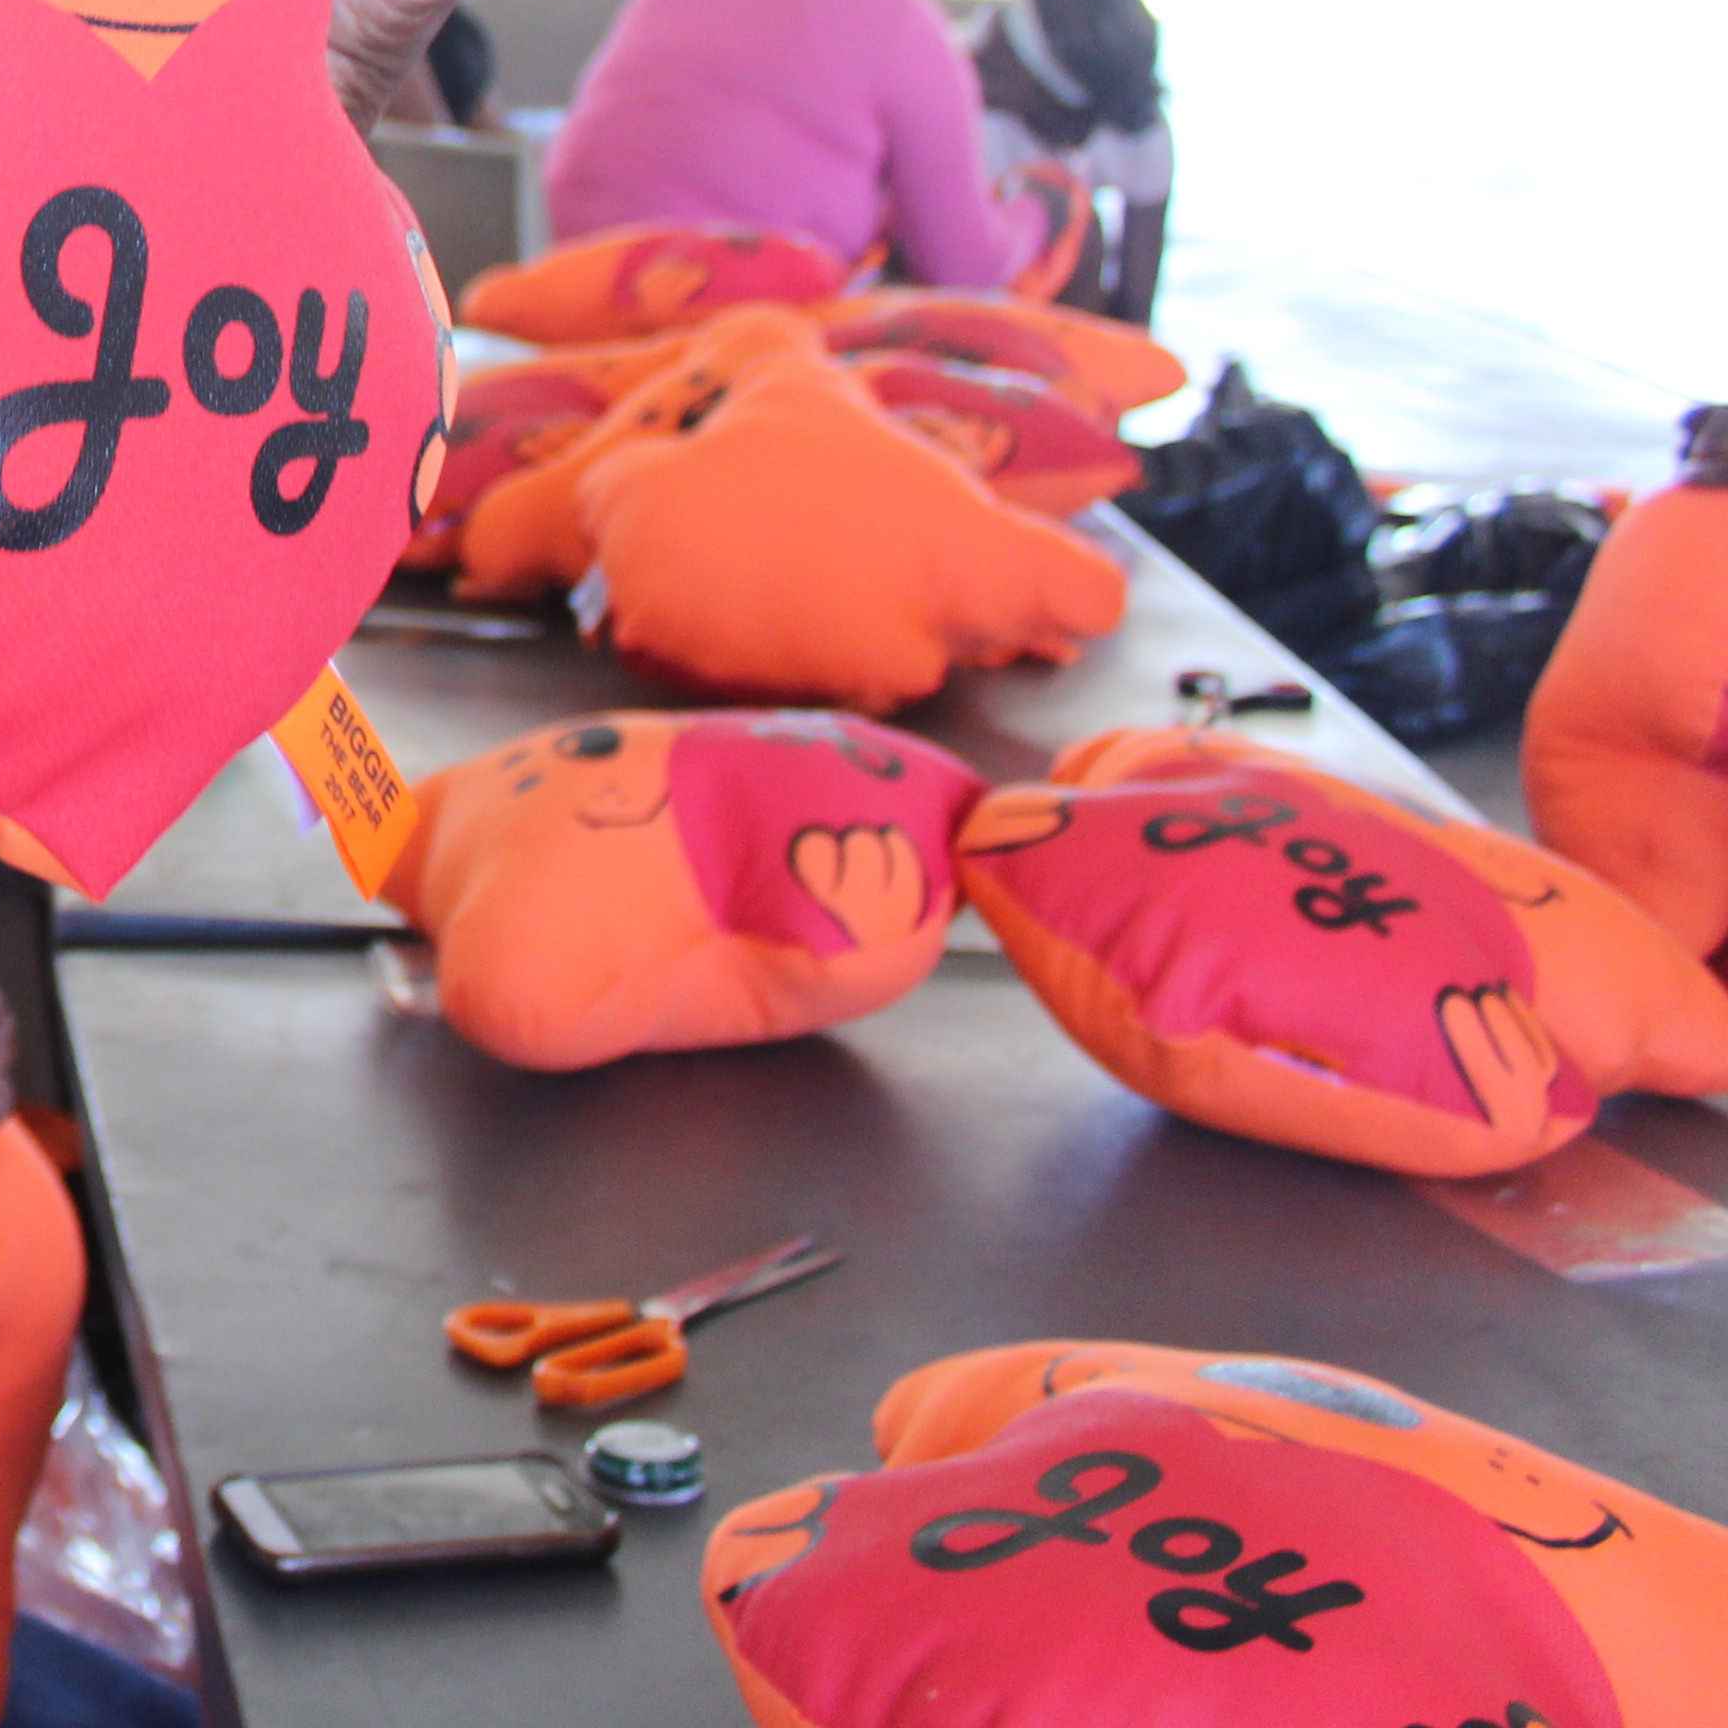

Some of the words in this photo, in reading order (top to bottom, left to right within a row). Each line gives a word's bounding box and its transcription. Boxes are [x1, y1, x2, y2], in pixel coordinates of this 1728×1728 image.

[321, 720, 348, 771] THE
[348, 769, 382, 832] BEAR
[325, 773, 356, 822] 2017
[329, 693, 400, 812] BIGGIE
[1142, 795, 1420, 938] Joy
[911, 1451, 1365, 1653] Joy
